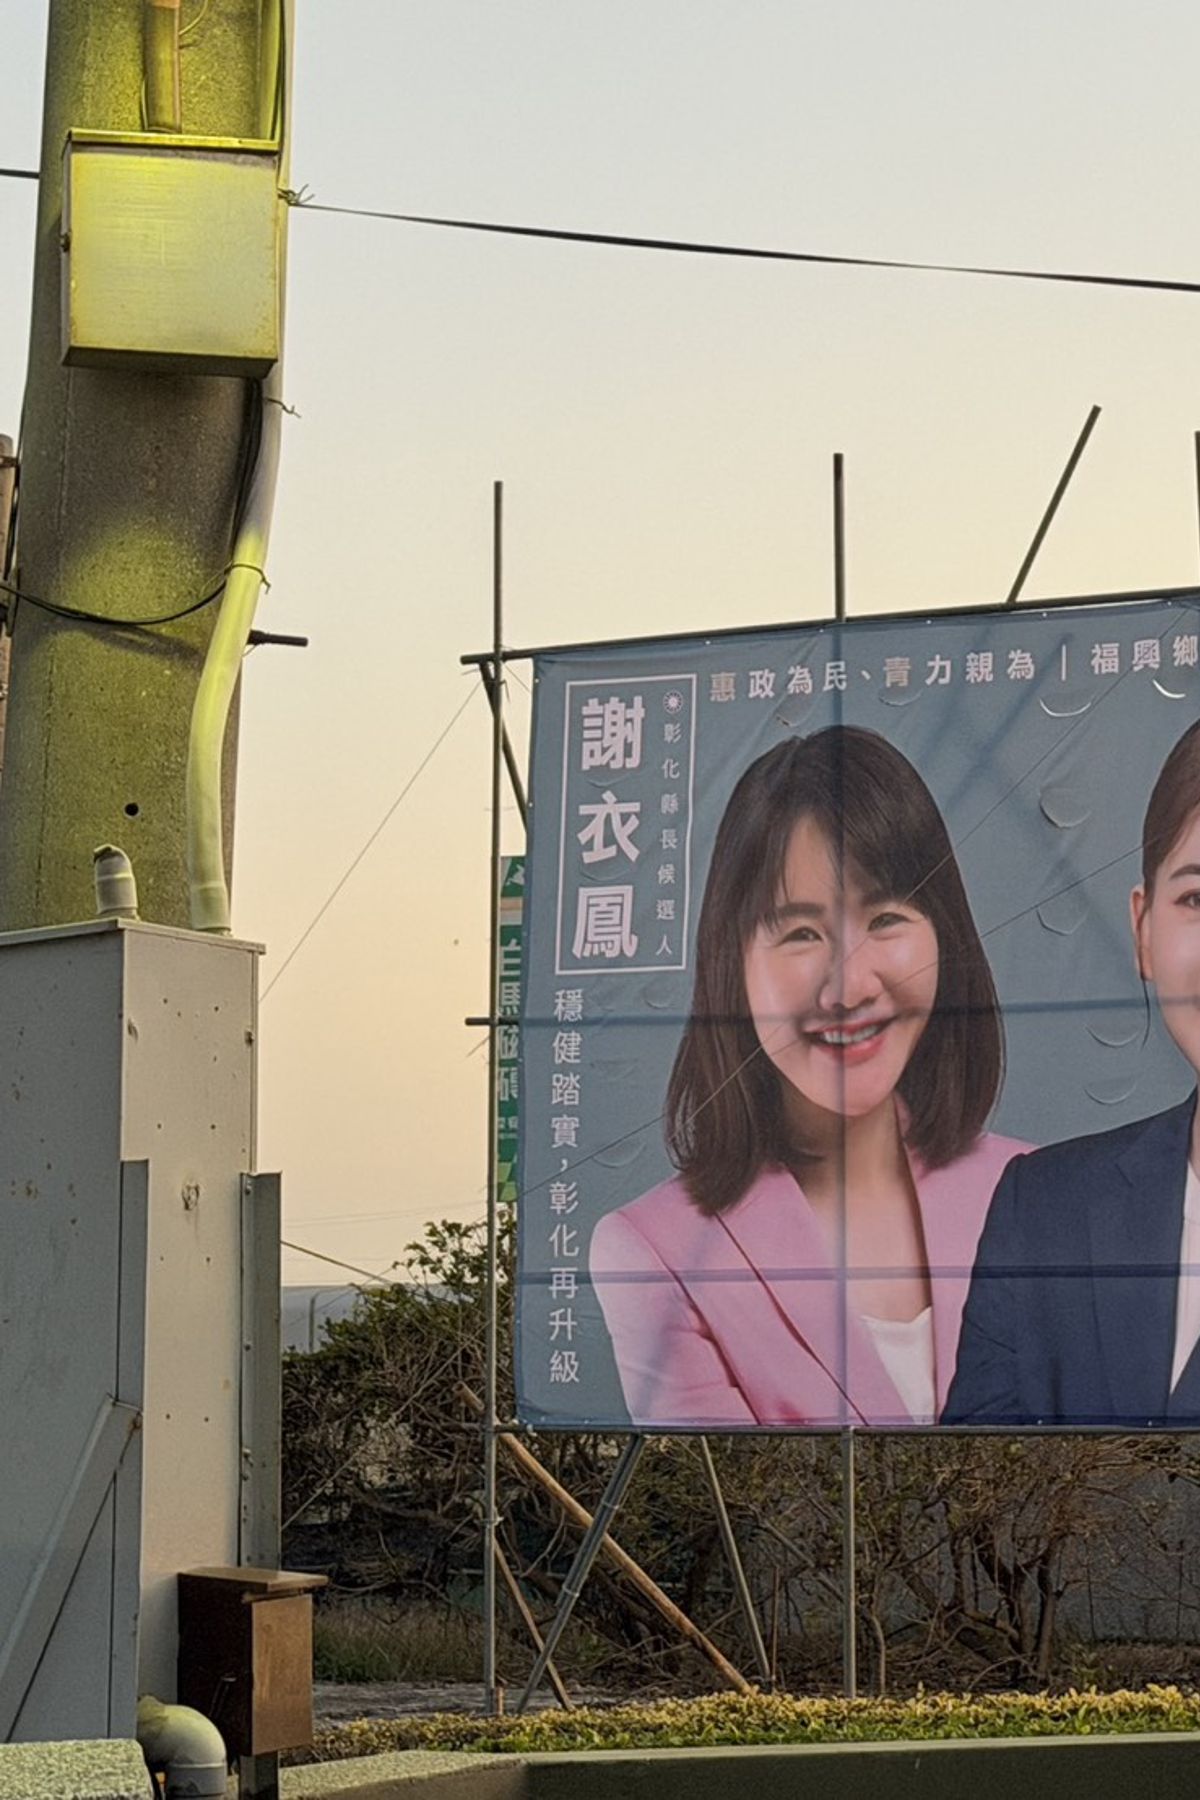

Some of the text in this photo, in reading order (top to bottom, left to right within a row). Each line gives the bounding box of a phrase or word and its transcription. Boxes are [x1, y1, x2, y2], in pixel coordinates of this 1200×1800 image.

[572, 695, 645, 959] 謝衣鳳
[655, 722, 682, 956] 彰化縣長候選人
[548, 989, 584, 1383] 穩健踏實，彰化再升級
